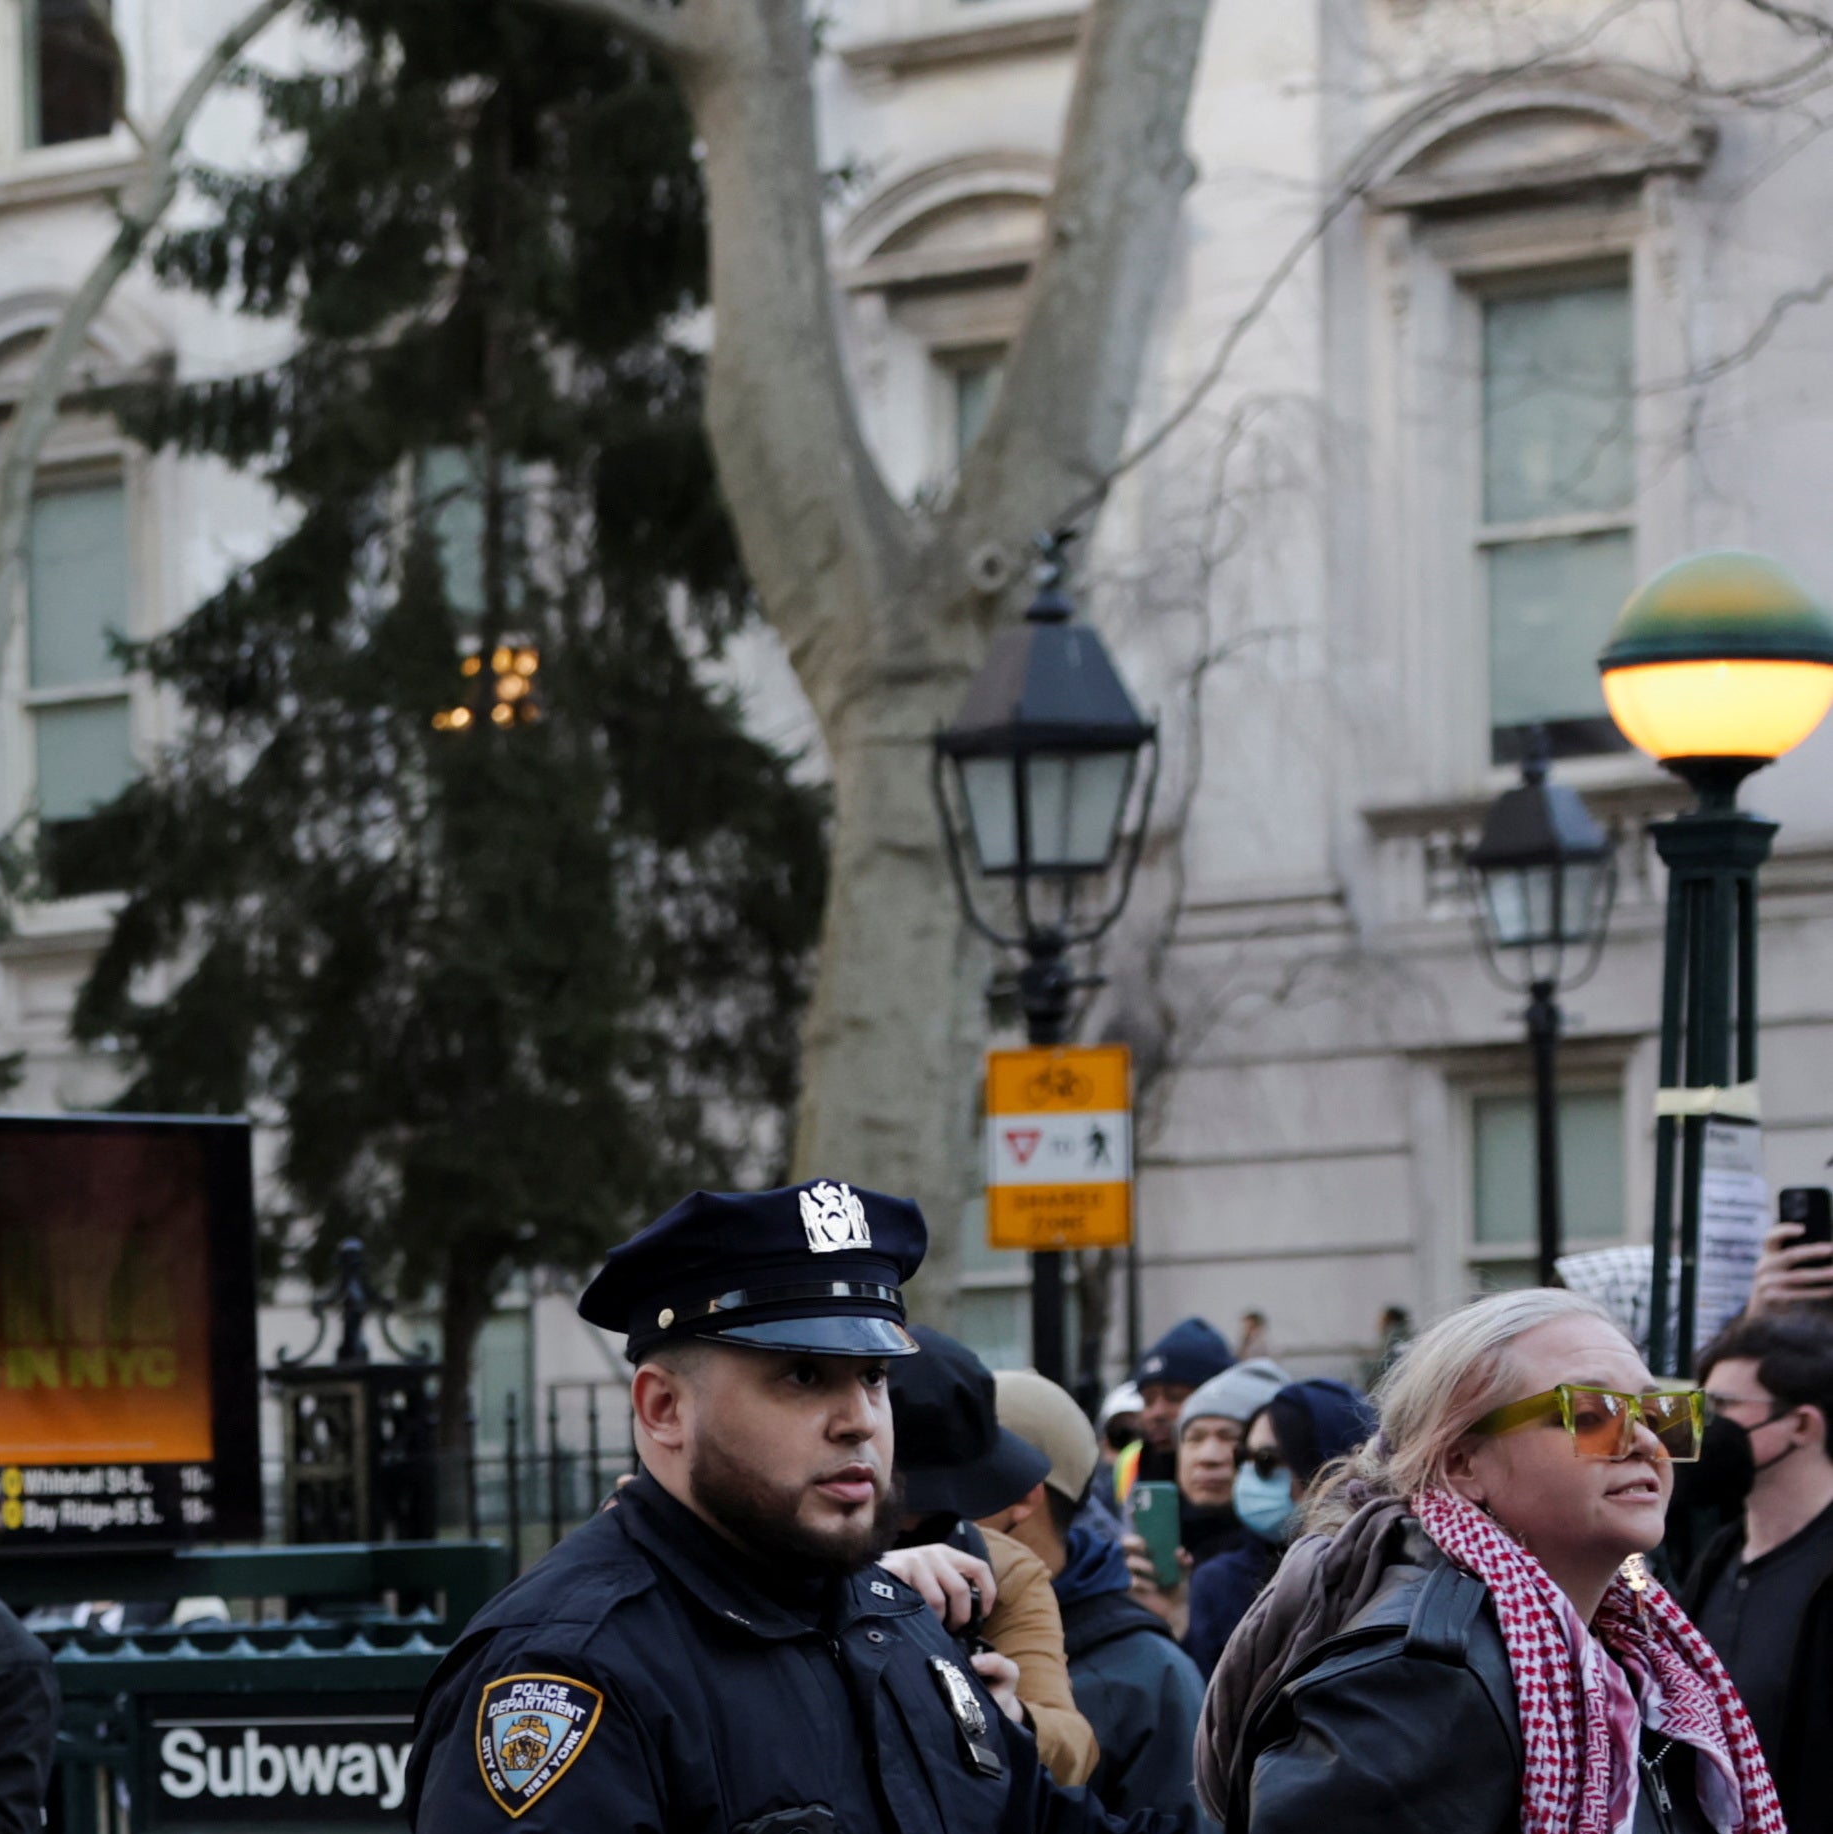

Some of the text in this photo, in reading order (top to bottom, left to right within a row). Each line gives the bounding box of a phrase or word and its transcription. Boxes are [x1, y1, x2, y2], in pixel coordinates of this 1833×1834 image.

[5, 1346, 61, 1388] IN
[68, 1345, 178, 1389] NYC
[487, 1697, 586, 1723] DEPARTMENT
[510, 1682, 570, 1700] POLICE
[160, 1728, 413, 1809] Subway
[481, 1735, 507, 1792] CITY OF
[523, 1729, 583, 1798] NEW YORK
